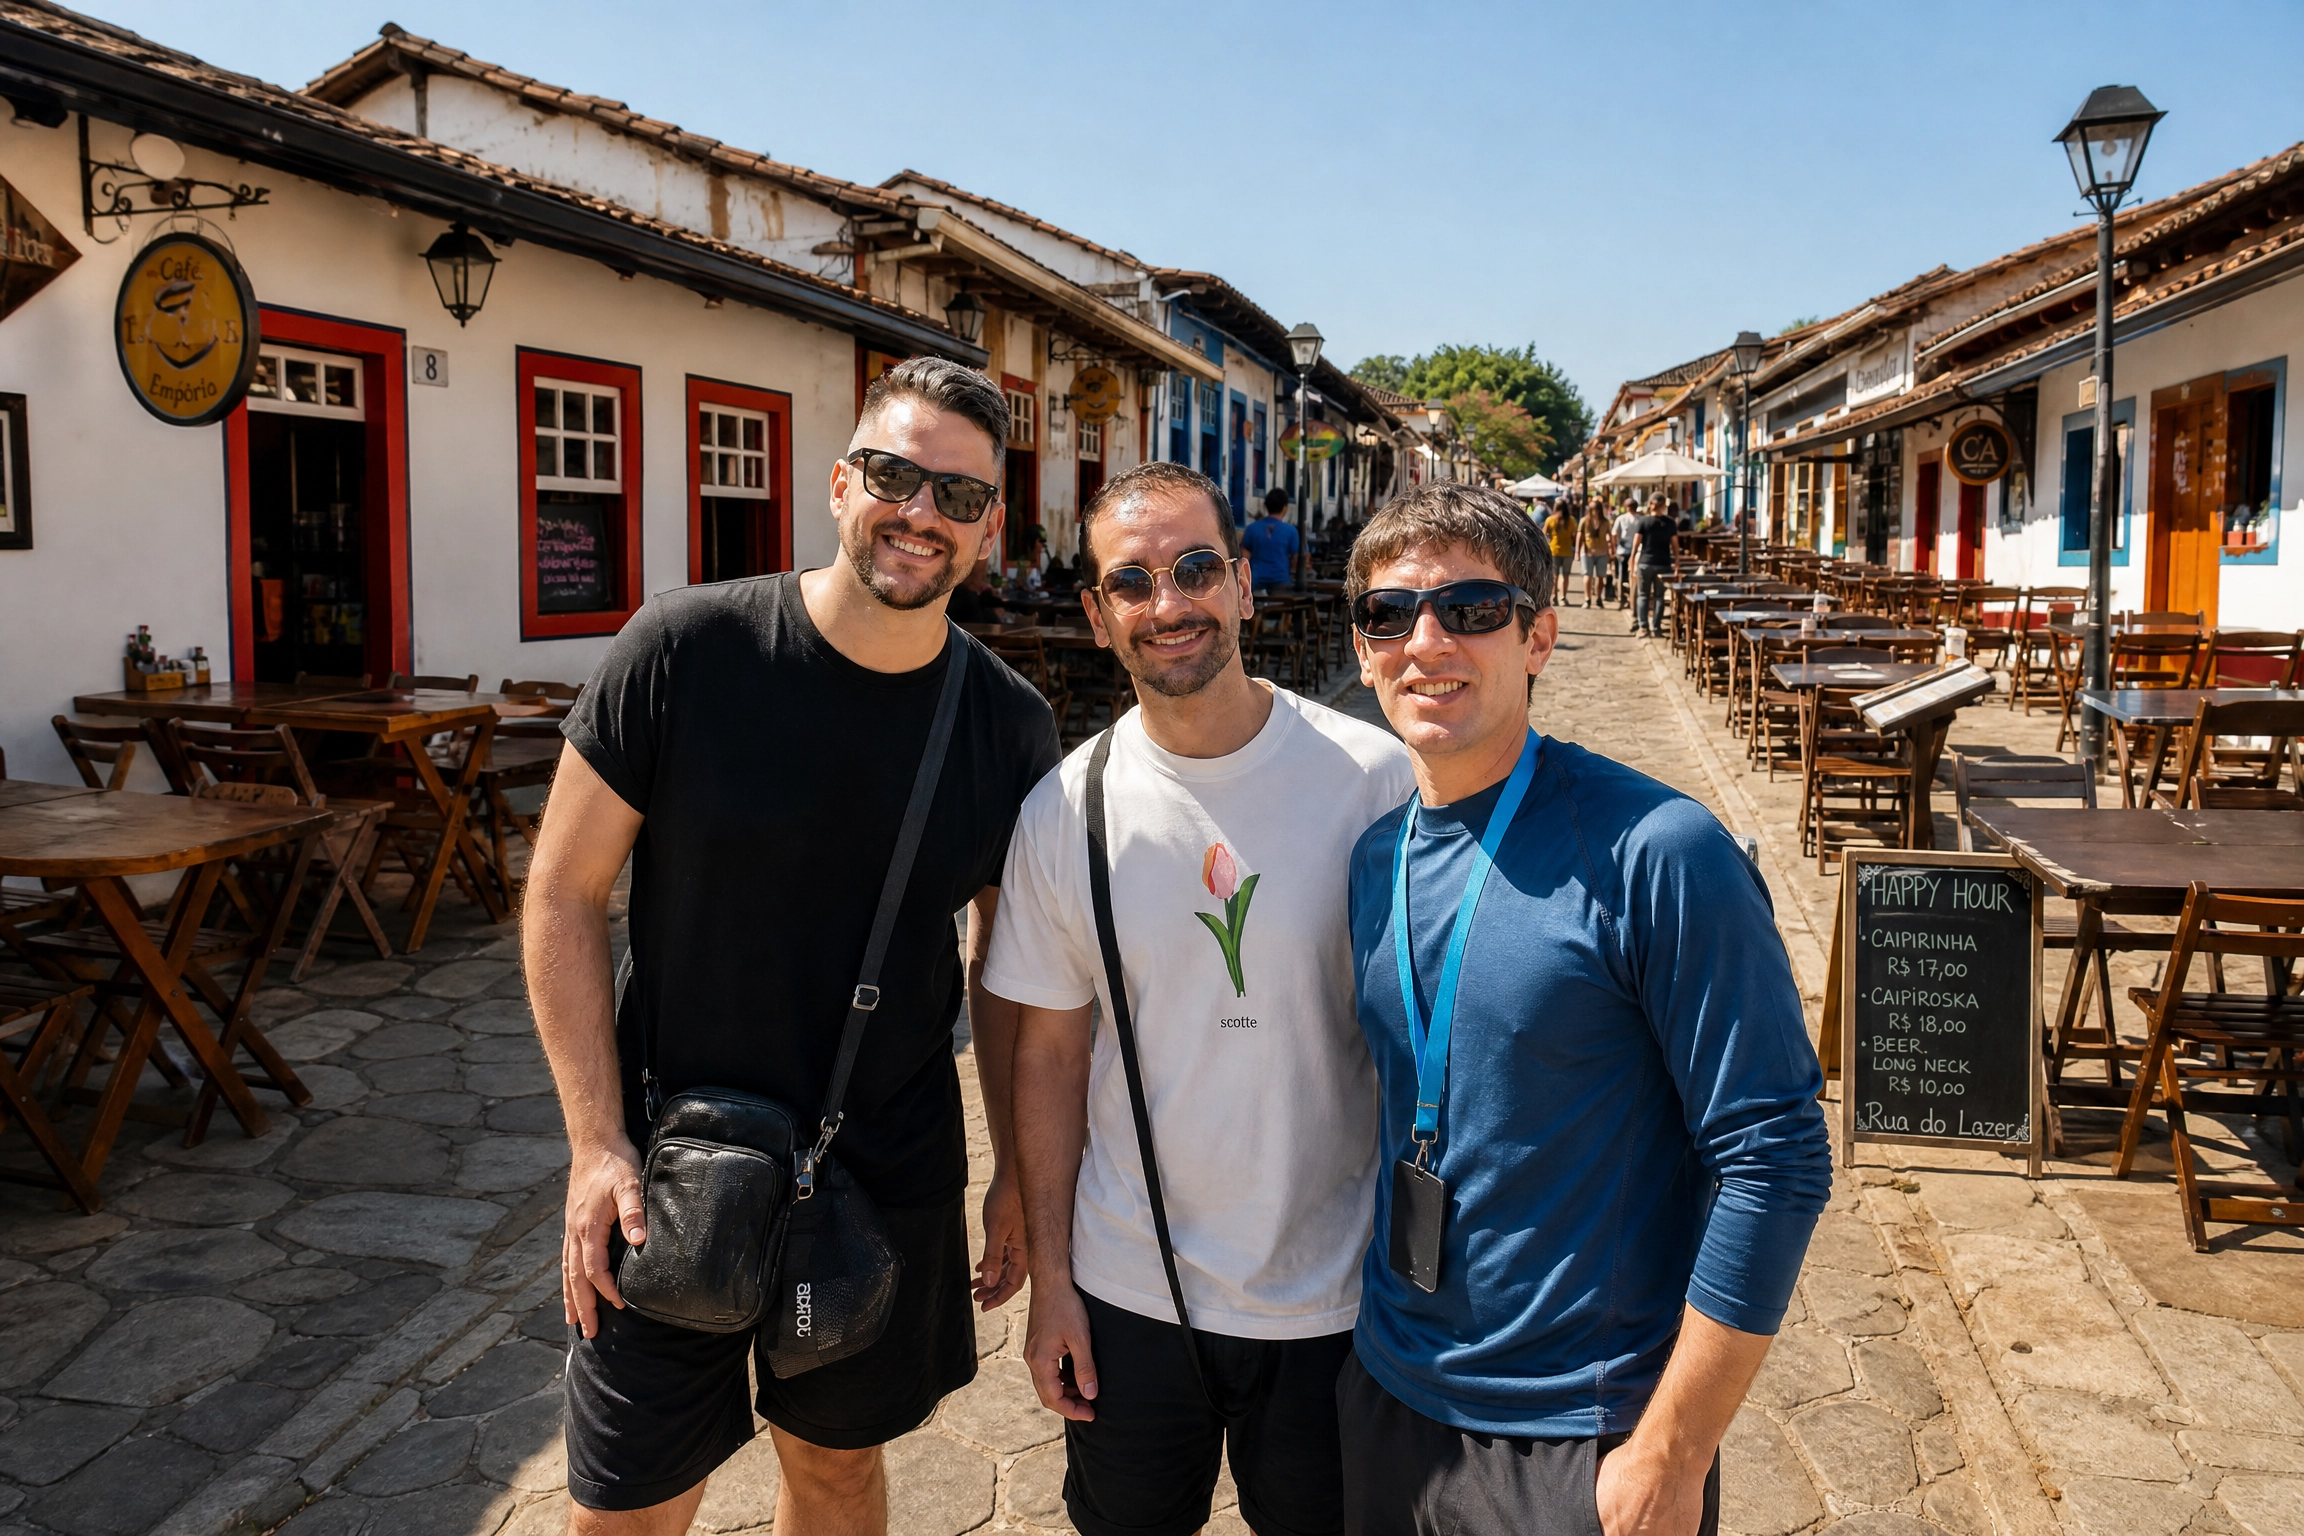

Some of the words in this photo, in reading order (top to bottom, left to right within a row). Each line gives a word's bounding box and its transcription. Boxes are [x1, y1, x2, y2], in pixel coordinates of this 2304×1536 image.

[160, 256, 203, 281] Café
[425, 353, 437, 381] 8
[1871, 875, 1941, 908] HAPPY
[1953, 878, 2013, 914] HOUR
[1871, 928, 1978, 952] CAIPIRINHA
[1888, 956, 1911, 977] R$
[1917, 958, 1968, 982] 17,00
[1220, 1016, 1258, 1028] scotte
[1888, 1012, 1912, 1033] R$
[1918, 1015, 1967, 1035] 18,00
[1872, 1056, 1917, 1072] LONG
[1924, 1059, 1972, 1074] NECK
[1888, 1076, 1911, 1095] R$
[1918, 1078, 1965, 1097] 10,00
[1865, 1101, 1910, 1131] Rua
[1920, 1107, 1946, 1134] do
[1958, 1109, 2015, 1138] Lazer
